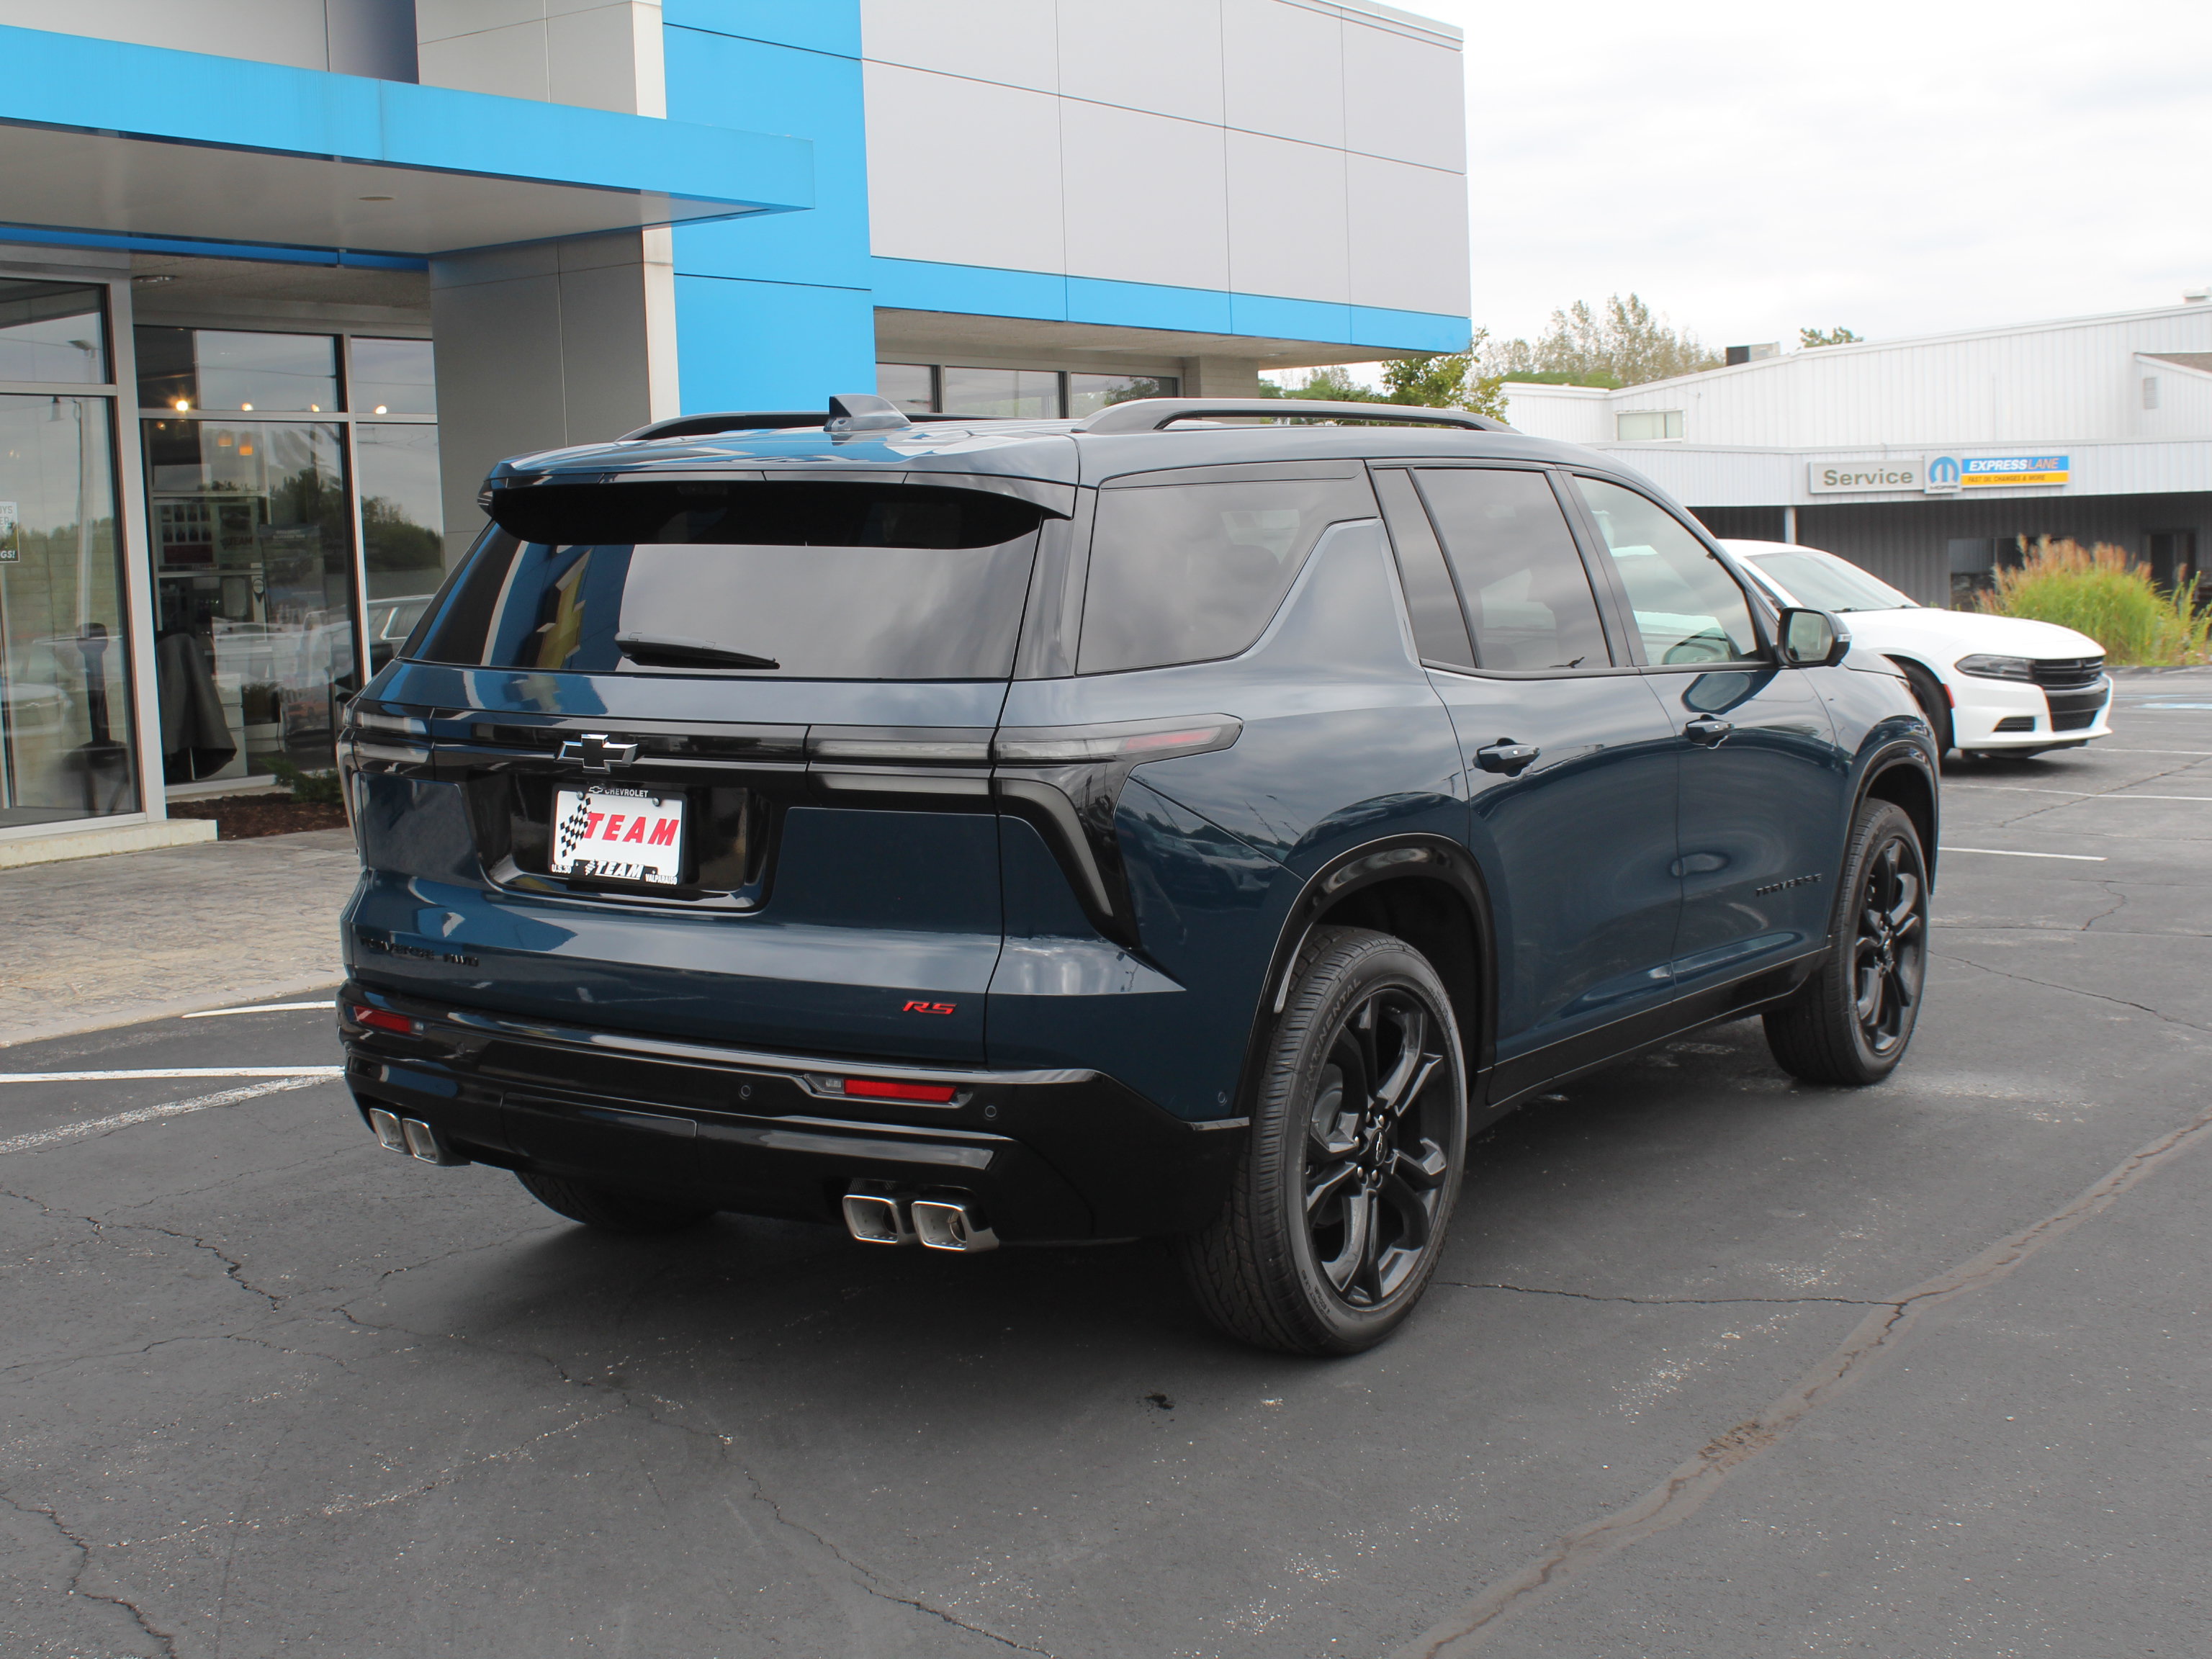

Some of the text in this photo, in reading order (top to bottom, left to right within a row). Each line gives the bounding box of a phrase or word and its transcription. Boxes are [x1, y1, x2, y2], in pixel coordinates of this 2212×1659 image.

[1823, 468, 1914, 487] Service
[604, 788, 649, 798] CHEVROLET
[583, 811, 680, 846] TEAM
[595, 860, 644, 878] TEAM
[645, 873, 678, 885] VALPARAISO
[902, 1000, 958, 1015] RS
